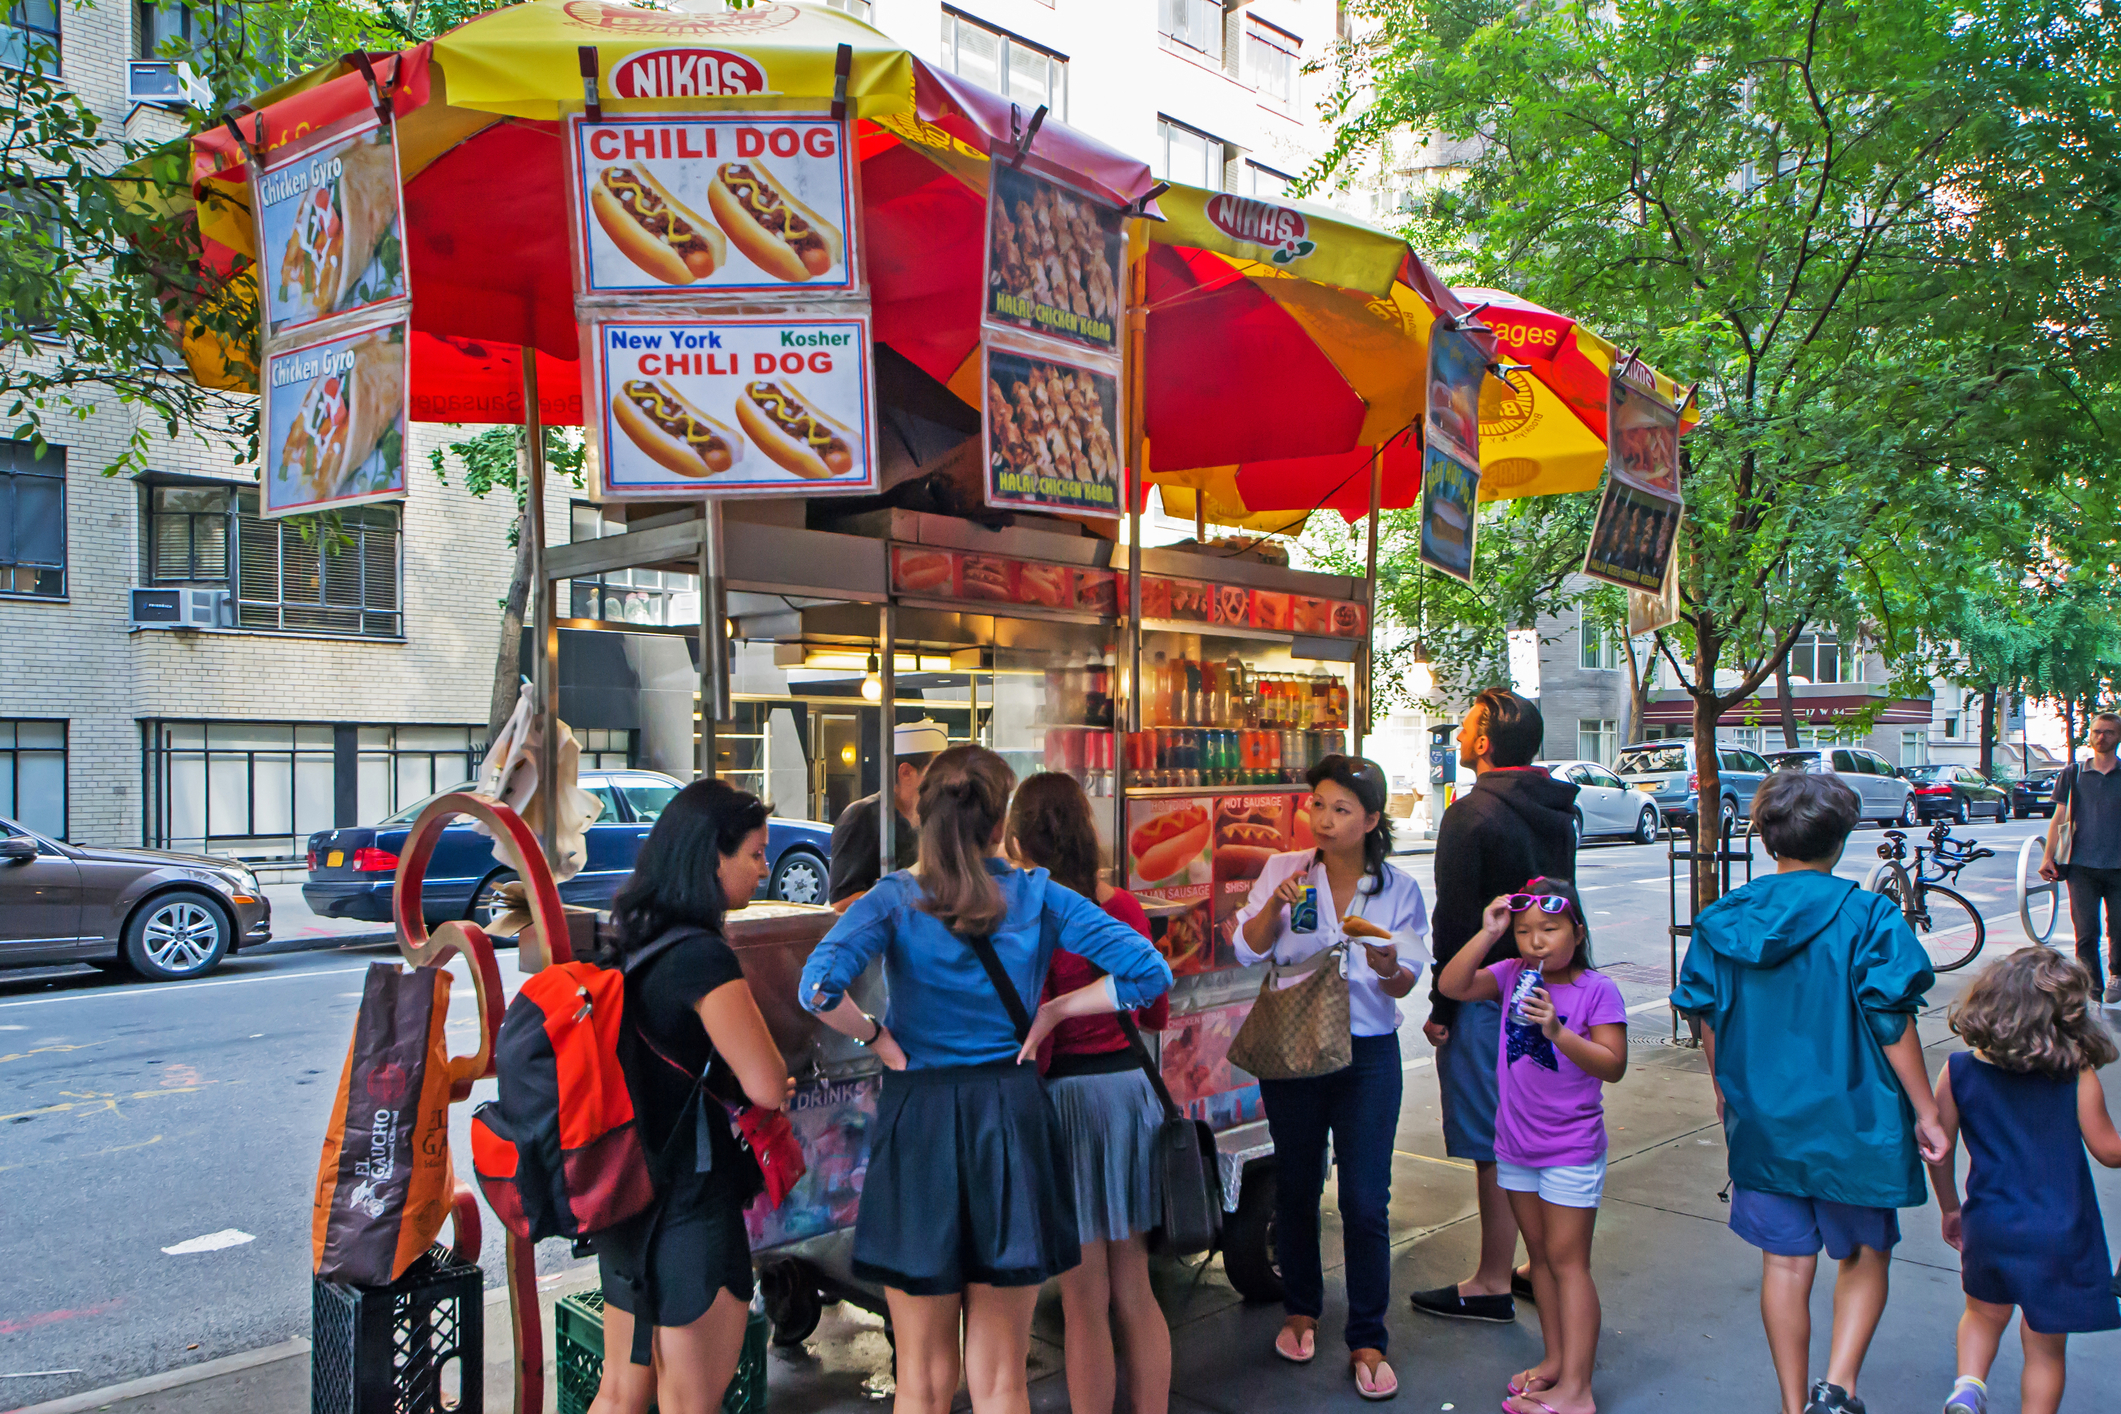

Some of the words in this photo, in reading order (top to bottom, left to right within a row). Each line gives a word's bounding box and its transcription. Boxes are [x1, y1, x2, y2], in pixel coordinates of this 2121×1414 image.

[632, 55, 749, 98] NIKAS
[590, 127, 717, 160] CHILI
[736, 127, 836, 159] DOG
[260, 169, 308, 208] Chicken
[310, 156, 343, 190] Gyro
[1218, 196, 1296, 242] NIKAS
[996, 291, 1032, 319] HALAL
[1035, 303, 1078, 332] CHICKEN
[1080, 316, 1111, 342] KEBAB
[611, 330, 662, 349] New
[669, 330, 722, 349] York
[780, 330, 851, 347] Kosher
[272, 354, 319, 388] Chicken
[322, 348, 356, 379] Gyro
[637, 352, 738, 376] CHILI
[753, 351, 833, 375] DOG
[999, 471, 1036, 493] HALAL
[1039, 477, 1082, 499] CHICKEN
[1084, 481, 1114, 503] KEBAB
[1805, 708, 1816, 716] 17
[1819, 708, 1829, 716] W
[1151, 800, 1170, 812] HOT
[1172, 799, 1192, 811] DOG
[1224, 797, 1242, 809] HOT
[1243, 796, 1282, 808] SAUSAGE
[1168, 885, 1210, 900] SAUSAGE
[1225, 881, 1250, 894] SHISH
[370, 1108, 391, 1180] GAUCHO
[355, 1157, 370, 1176] EL
